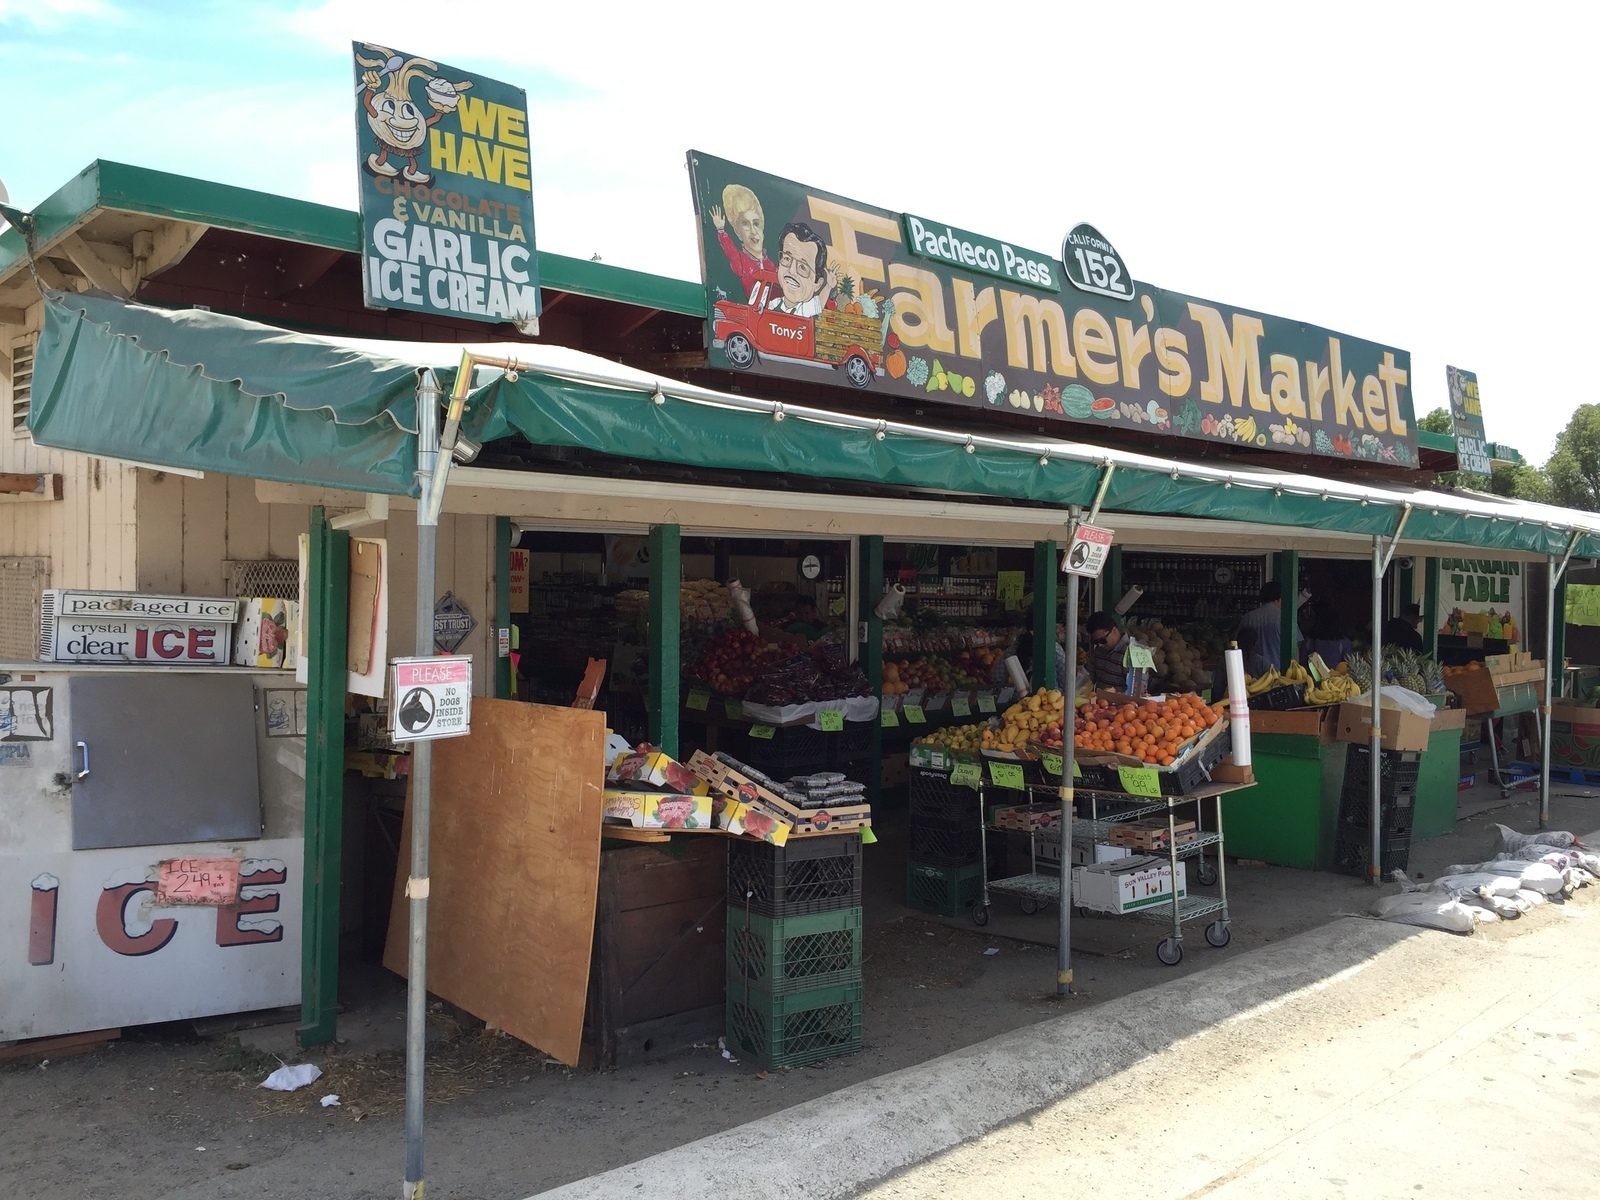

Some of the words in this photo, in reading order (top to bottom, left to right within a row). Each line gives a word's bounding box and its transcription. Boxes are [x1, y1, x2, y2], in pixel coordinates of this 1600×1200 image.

[458, 94, 528, 149] WE
[430, 128, 531, 191] HAVE
[374, 174, 521, 224] CHOCOLATE
[412, 201, 526, 243] VANILLA
[373, 218, 530, 284] GARLIC
[909, 217, 1000, 272] Pacheco
[1001, 244, 1052, 286] Pass
[1068, 234, 1115, 256] CALIFORNIA
[1075, 248, 1126, 293] 152
[369, 257, 424, 306] ICE
[428, 269, 535, 321] CREAM
[806, 194, 1192, 397] Farmer's
[1187, 302, 1408, 437] Market
[1466, 381, 1479, 398] WE
[1464, 397, 1482, 416] HAVE
[1458, 436, 1487, 457] GARLIC
[1083, 530, 1104, 542] PLEASE
[1451, 574, 1510, 603] TABLE
[72, 599, 189, 618] packaged
[198, 603, 231, 616] ice
[72, 623, 128, 639] crystal
[448, 619, 469, 629] TRUST
[67, 635, 129, 656] clear
[135, 623, 216, 660] ICE
[412, 666, 453, 683] PLEASE
[440, 697, 460, 706] DOGS
[446, 688, 456, 696] NO
[436, 707, 463, 717] INSIDE
[437, 717, 462, 727] STORE
[165, 859, 198, 874] ICE
[1124, 879, 1137, 889] SUN
[1137, 873, 1157, 883] VALLEY
[1158, 869, 1180, 878] PACKG
[28, 857, 287, 966] ICE
